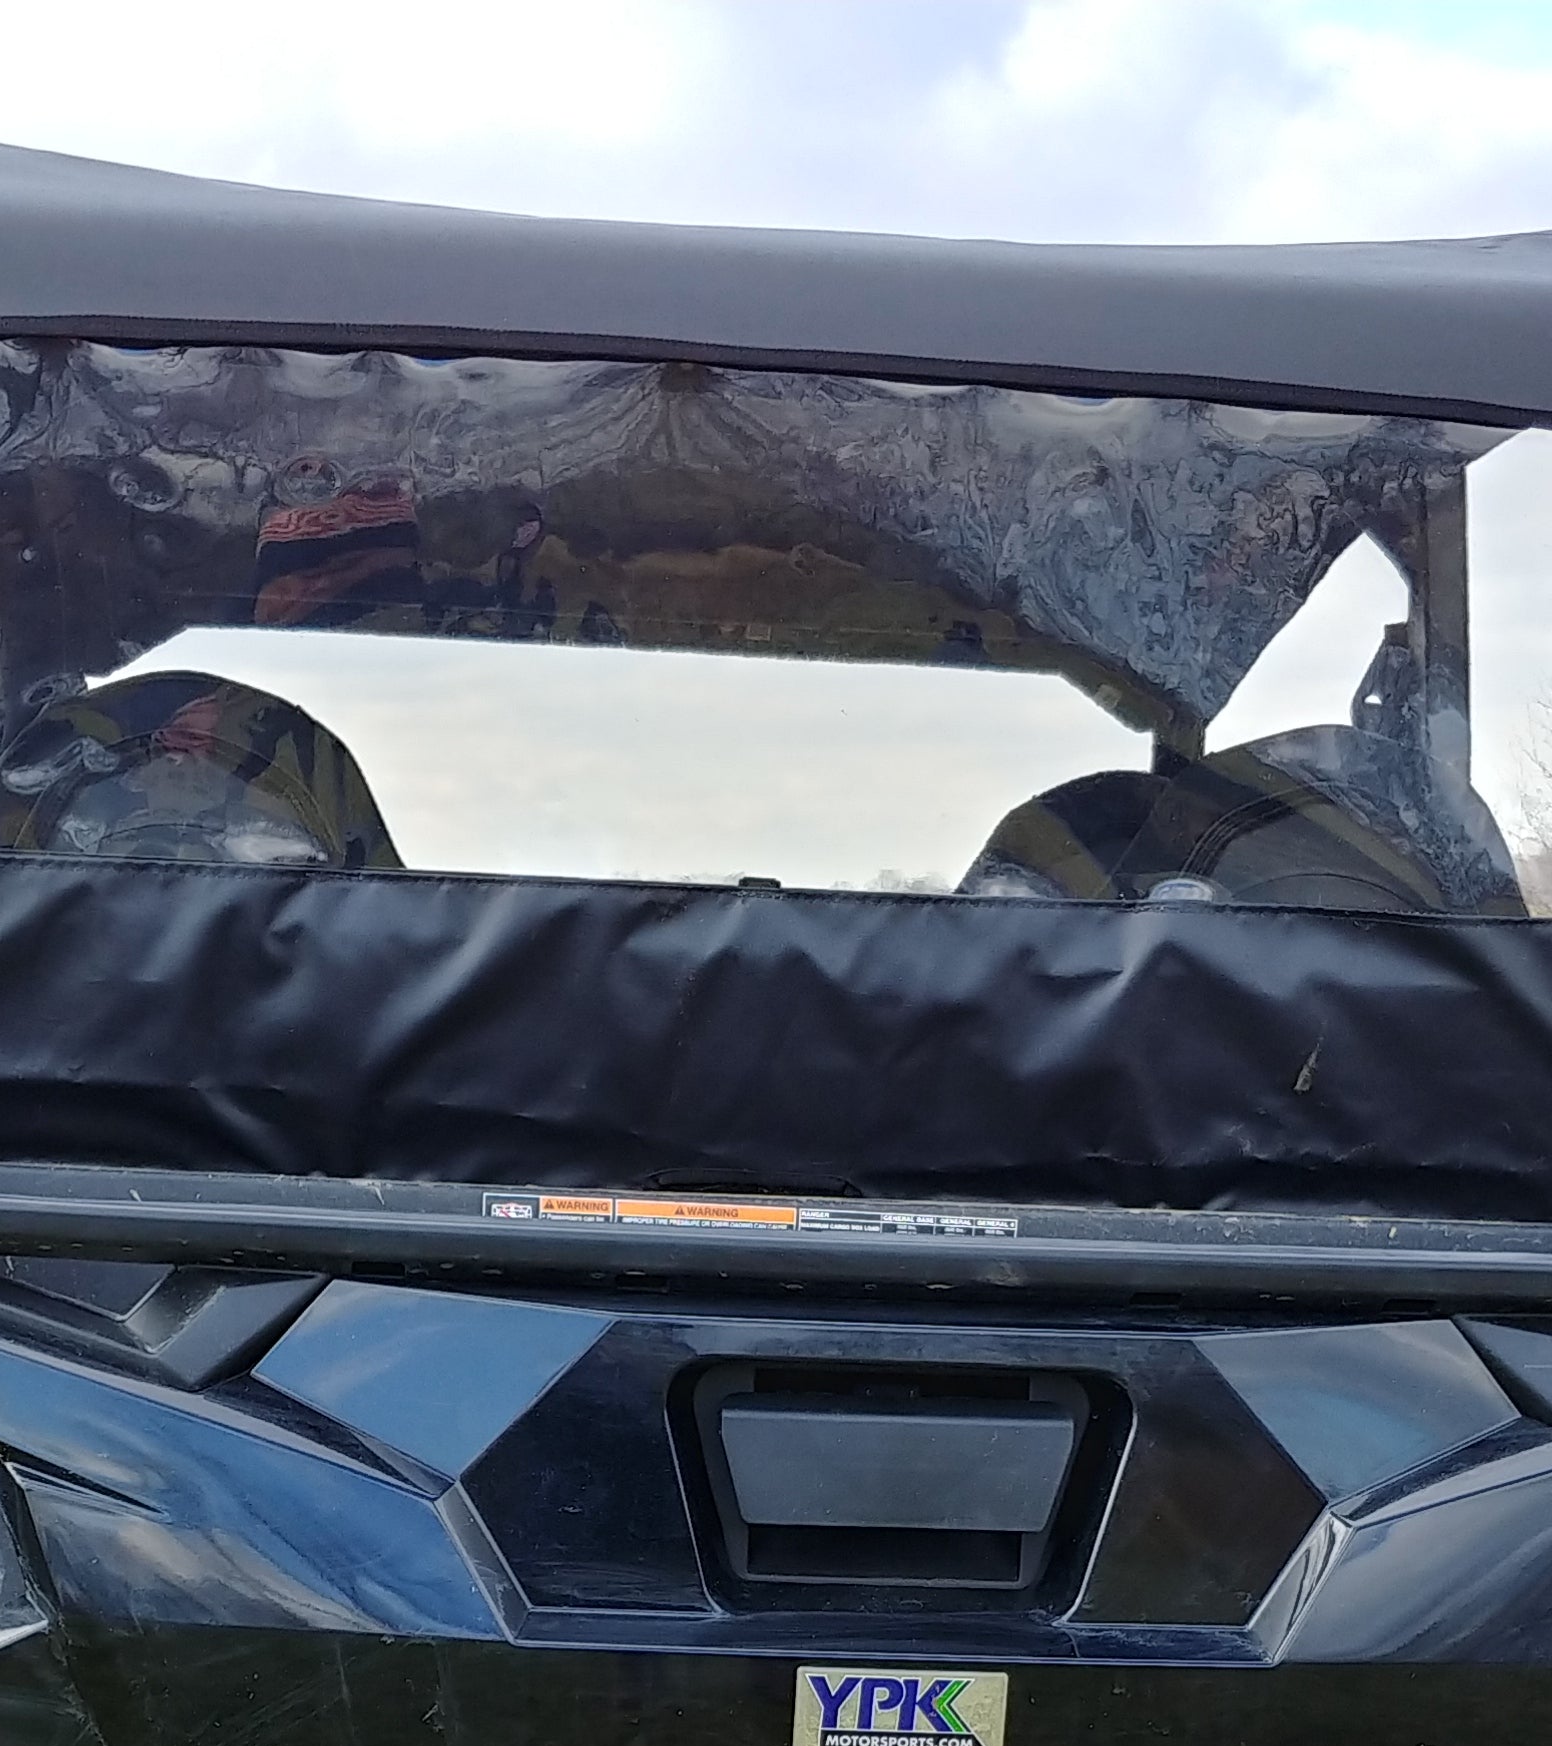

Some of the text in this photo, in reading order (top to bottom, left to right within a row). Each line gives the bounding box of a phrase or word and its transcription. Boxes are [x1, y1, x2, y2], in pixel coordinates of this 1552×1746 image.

[556, 1200, 609, 1211] WARNING
[686, 1207, 739, 1218] WARNING
[916, 1216, 934, 1224] BASE
[806, 1674, 974, 1733] YPK
